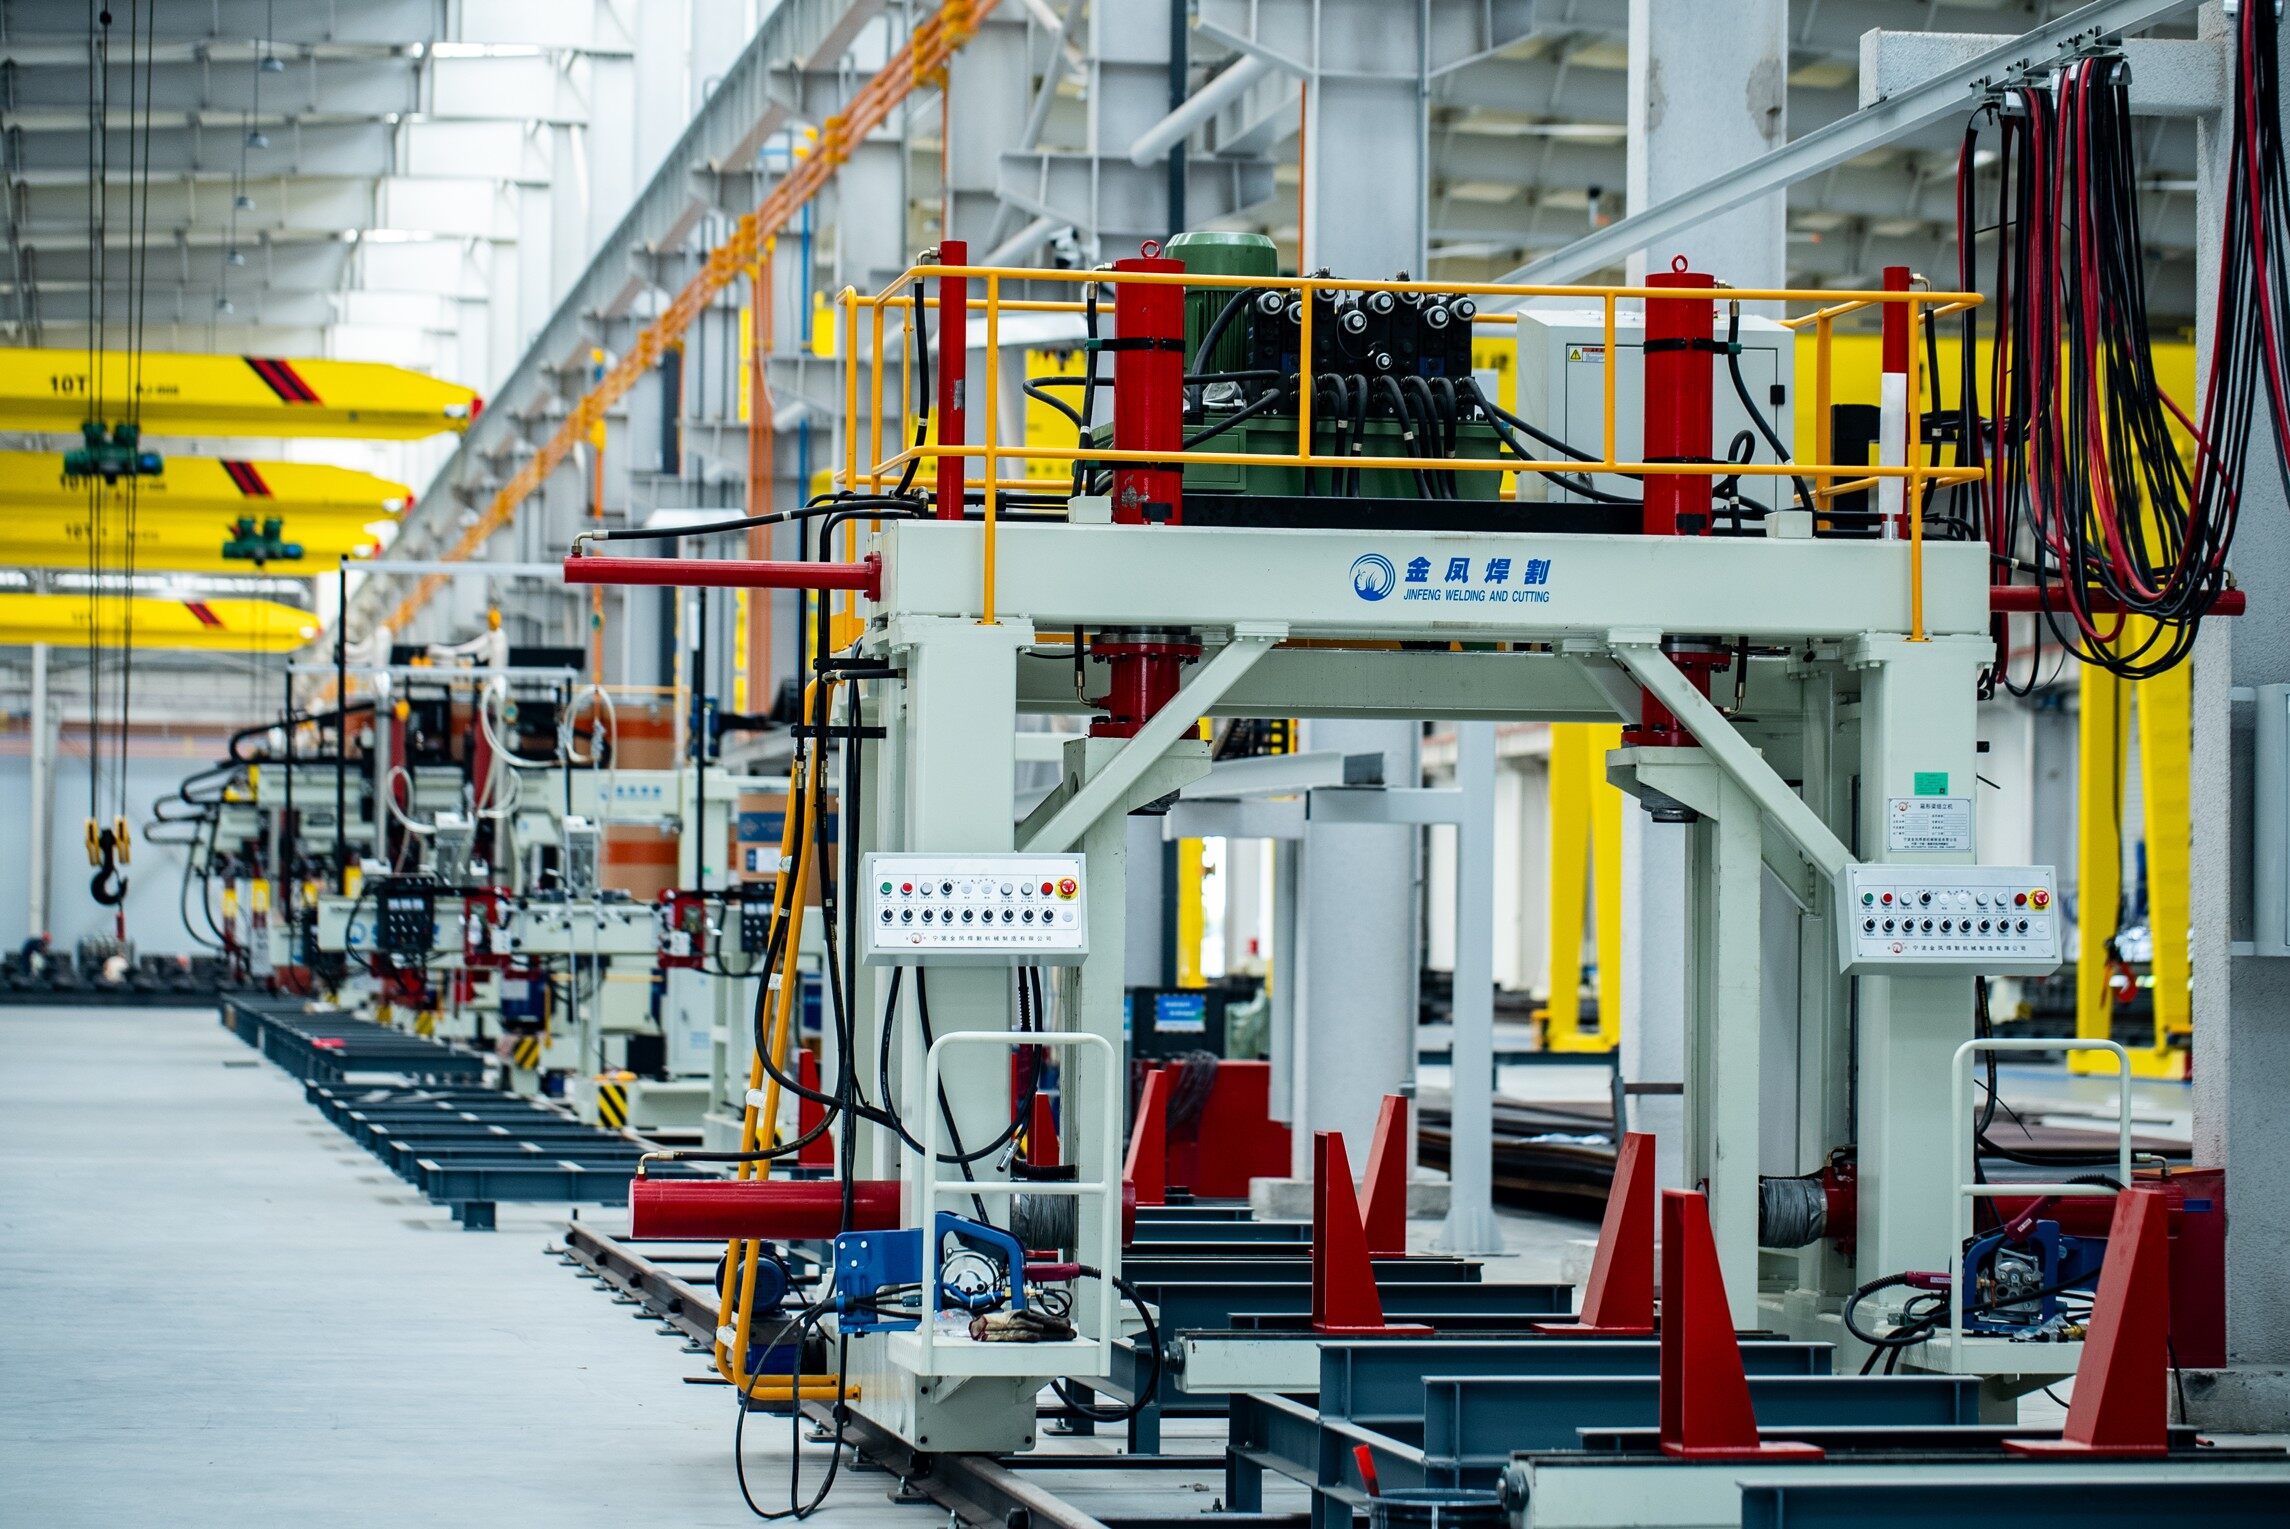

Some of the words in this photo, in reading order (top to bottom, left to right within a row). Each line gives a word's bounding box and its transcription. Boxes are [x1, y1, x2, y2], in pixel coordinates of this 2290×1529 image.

[51, 375, 87, 394] 10T
[1404, 556, 1552, 585] 金凤焊割
[1403, 588, 1441, 601] JINFENG
[1445, 589, 1485, 602] WELDING
[1489, 590, 1508, 602] AND
[1512, 590, 1550, 603] CUTTING
